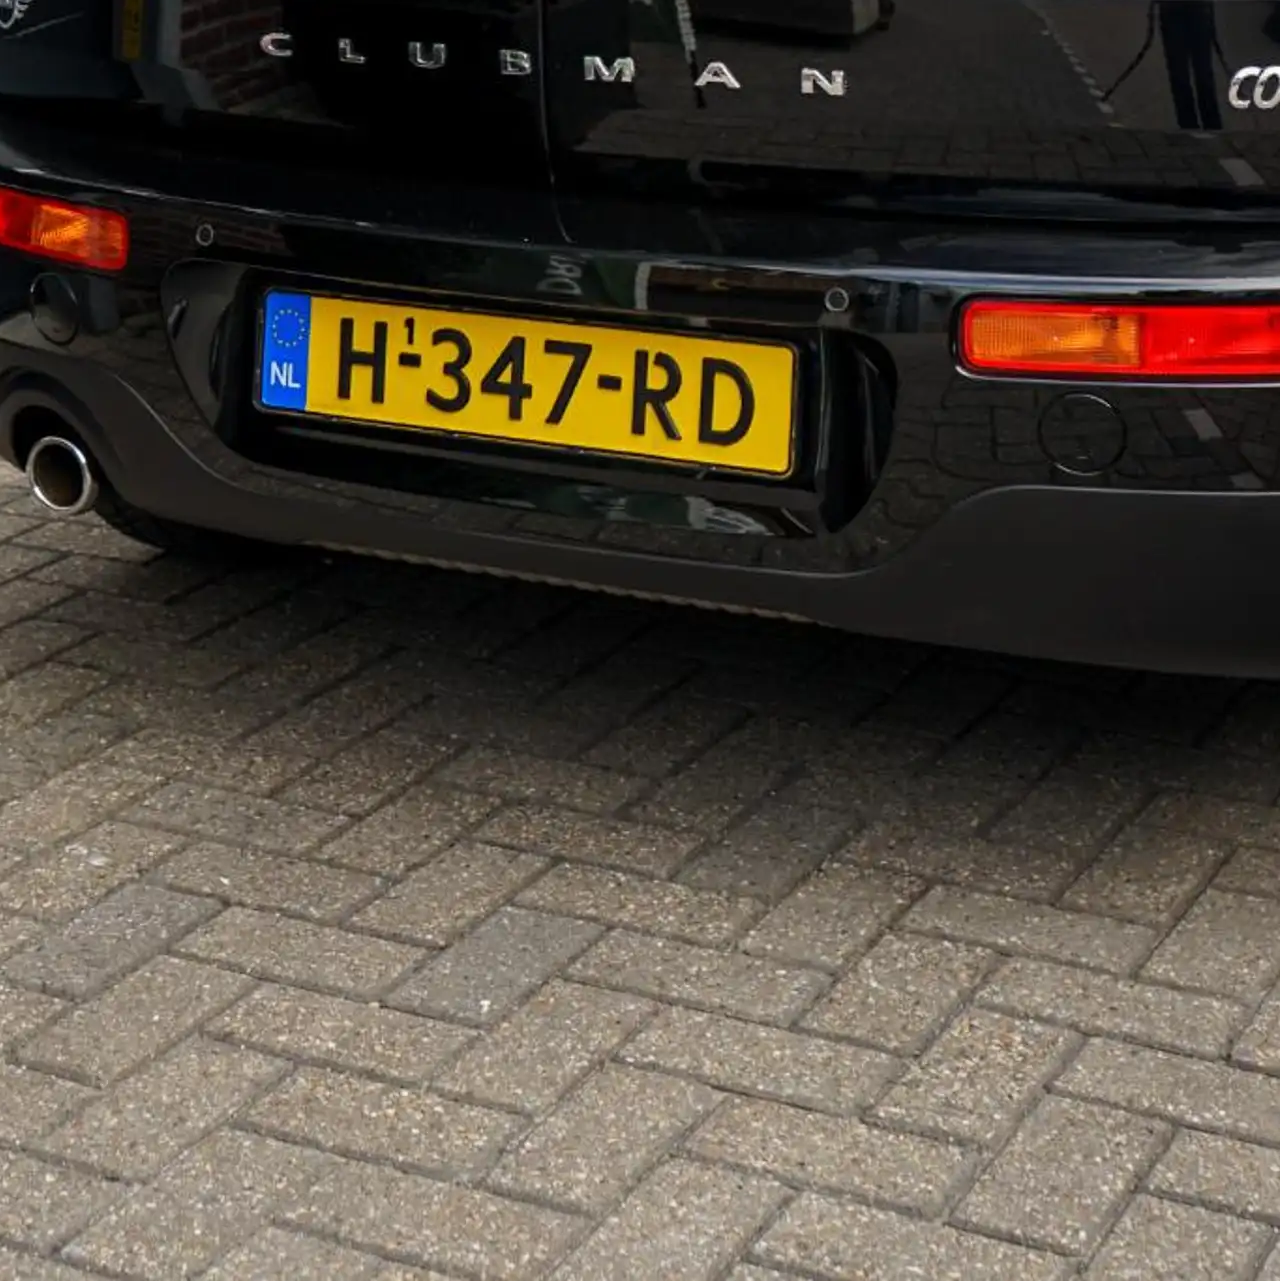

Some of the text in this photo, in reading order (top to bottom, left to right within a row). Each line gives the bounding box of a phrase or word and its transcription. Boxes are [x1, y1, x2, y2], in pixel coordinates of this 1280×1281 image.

[260, 32, 846, 96] CLUBMAN
[271, 361, 300, 388] NL
[337, 317, 755, 446] H-347-RD
